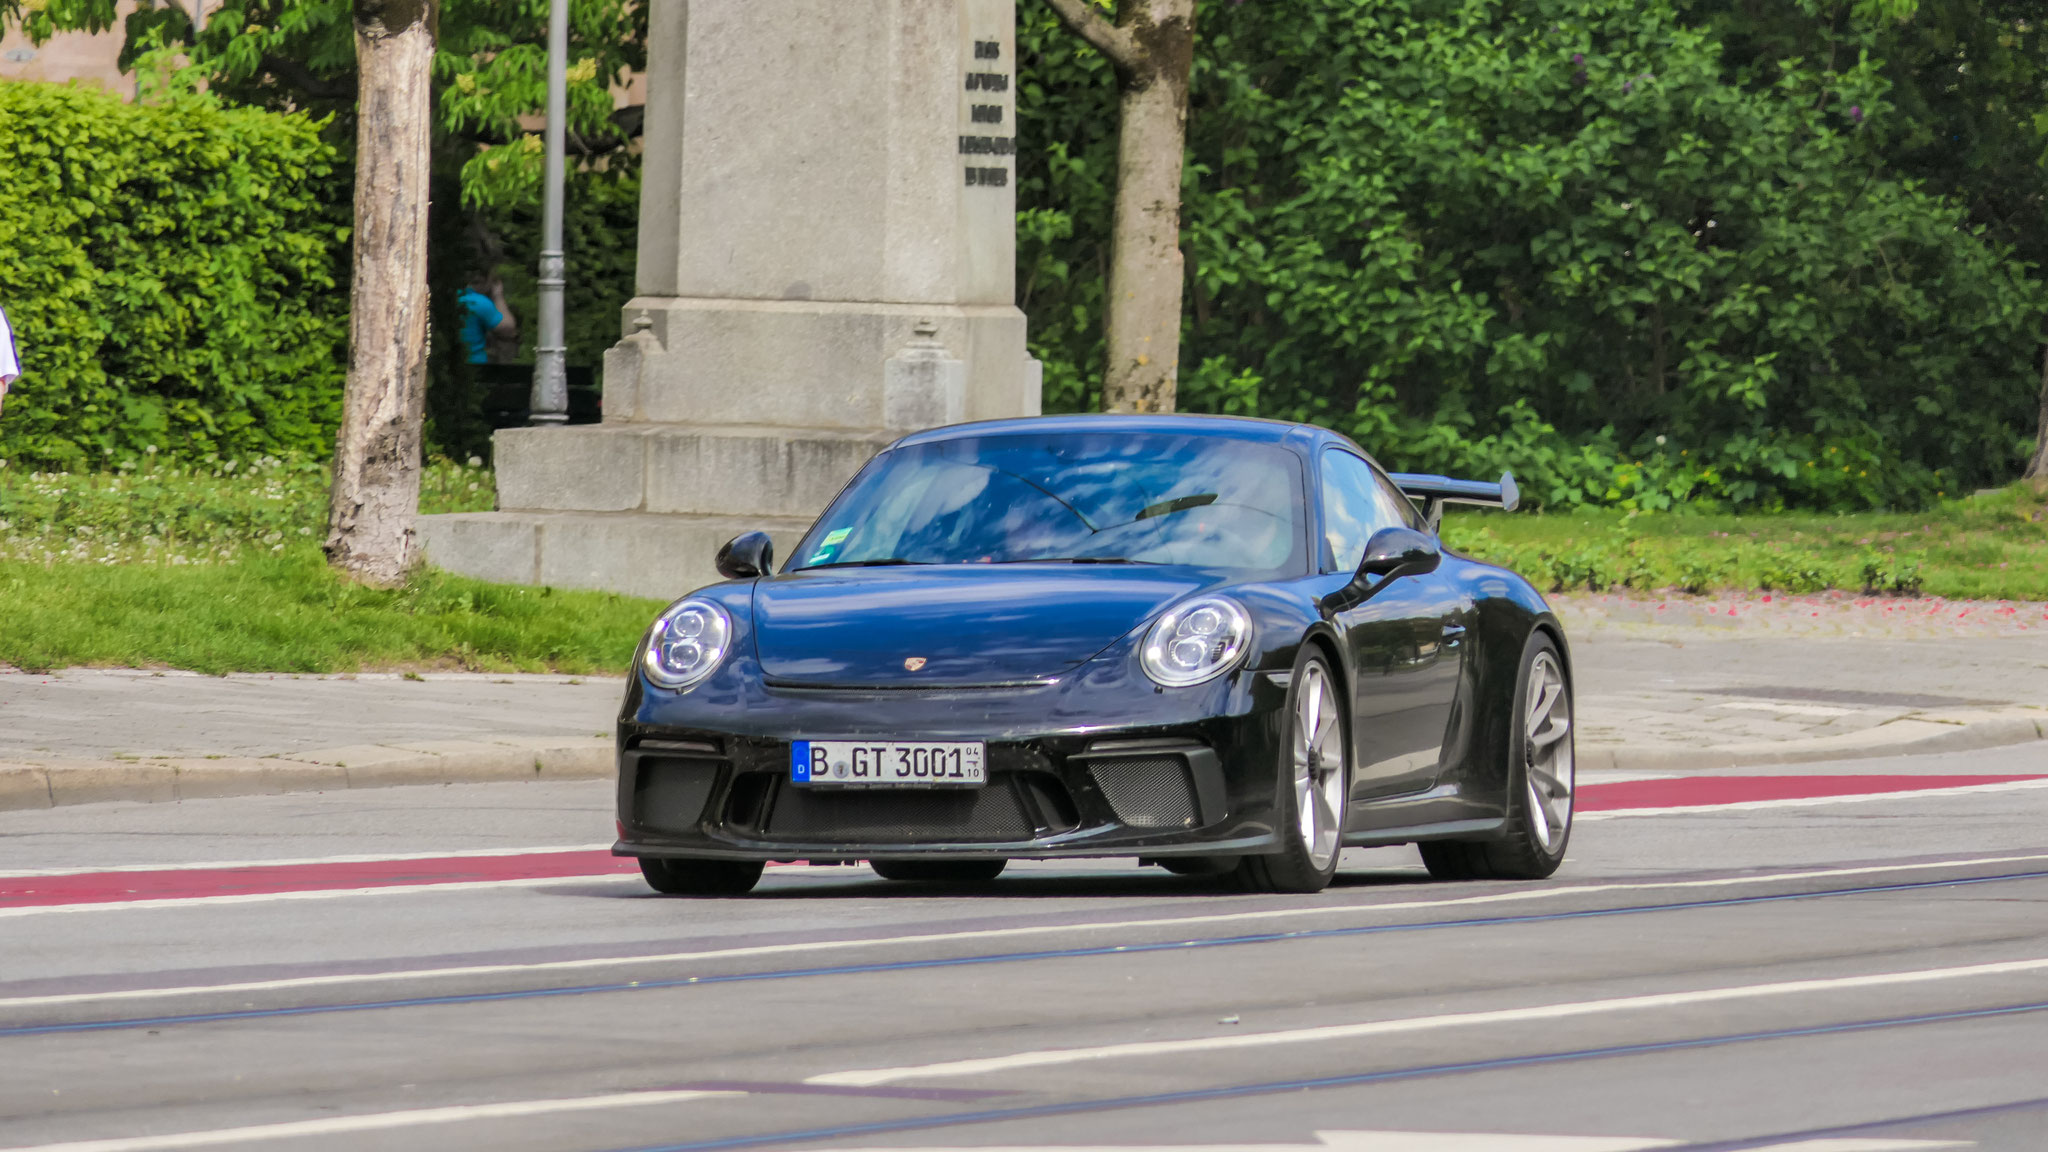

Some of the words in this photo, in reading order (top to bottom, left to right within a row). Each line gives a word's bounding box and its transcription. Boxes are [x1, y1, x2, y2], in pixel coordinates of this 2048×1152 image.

[966, 747, 979, 756] 04
[810, 747, 828, 776] B
[852, 747, 886, 777] GT
[896, 747, 964, 777] 3001
[797, 764, 805, 774] D
[967, 768, 979, 778] 10
